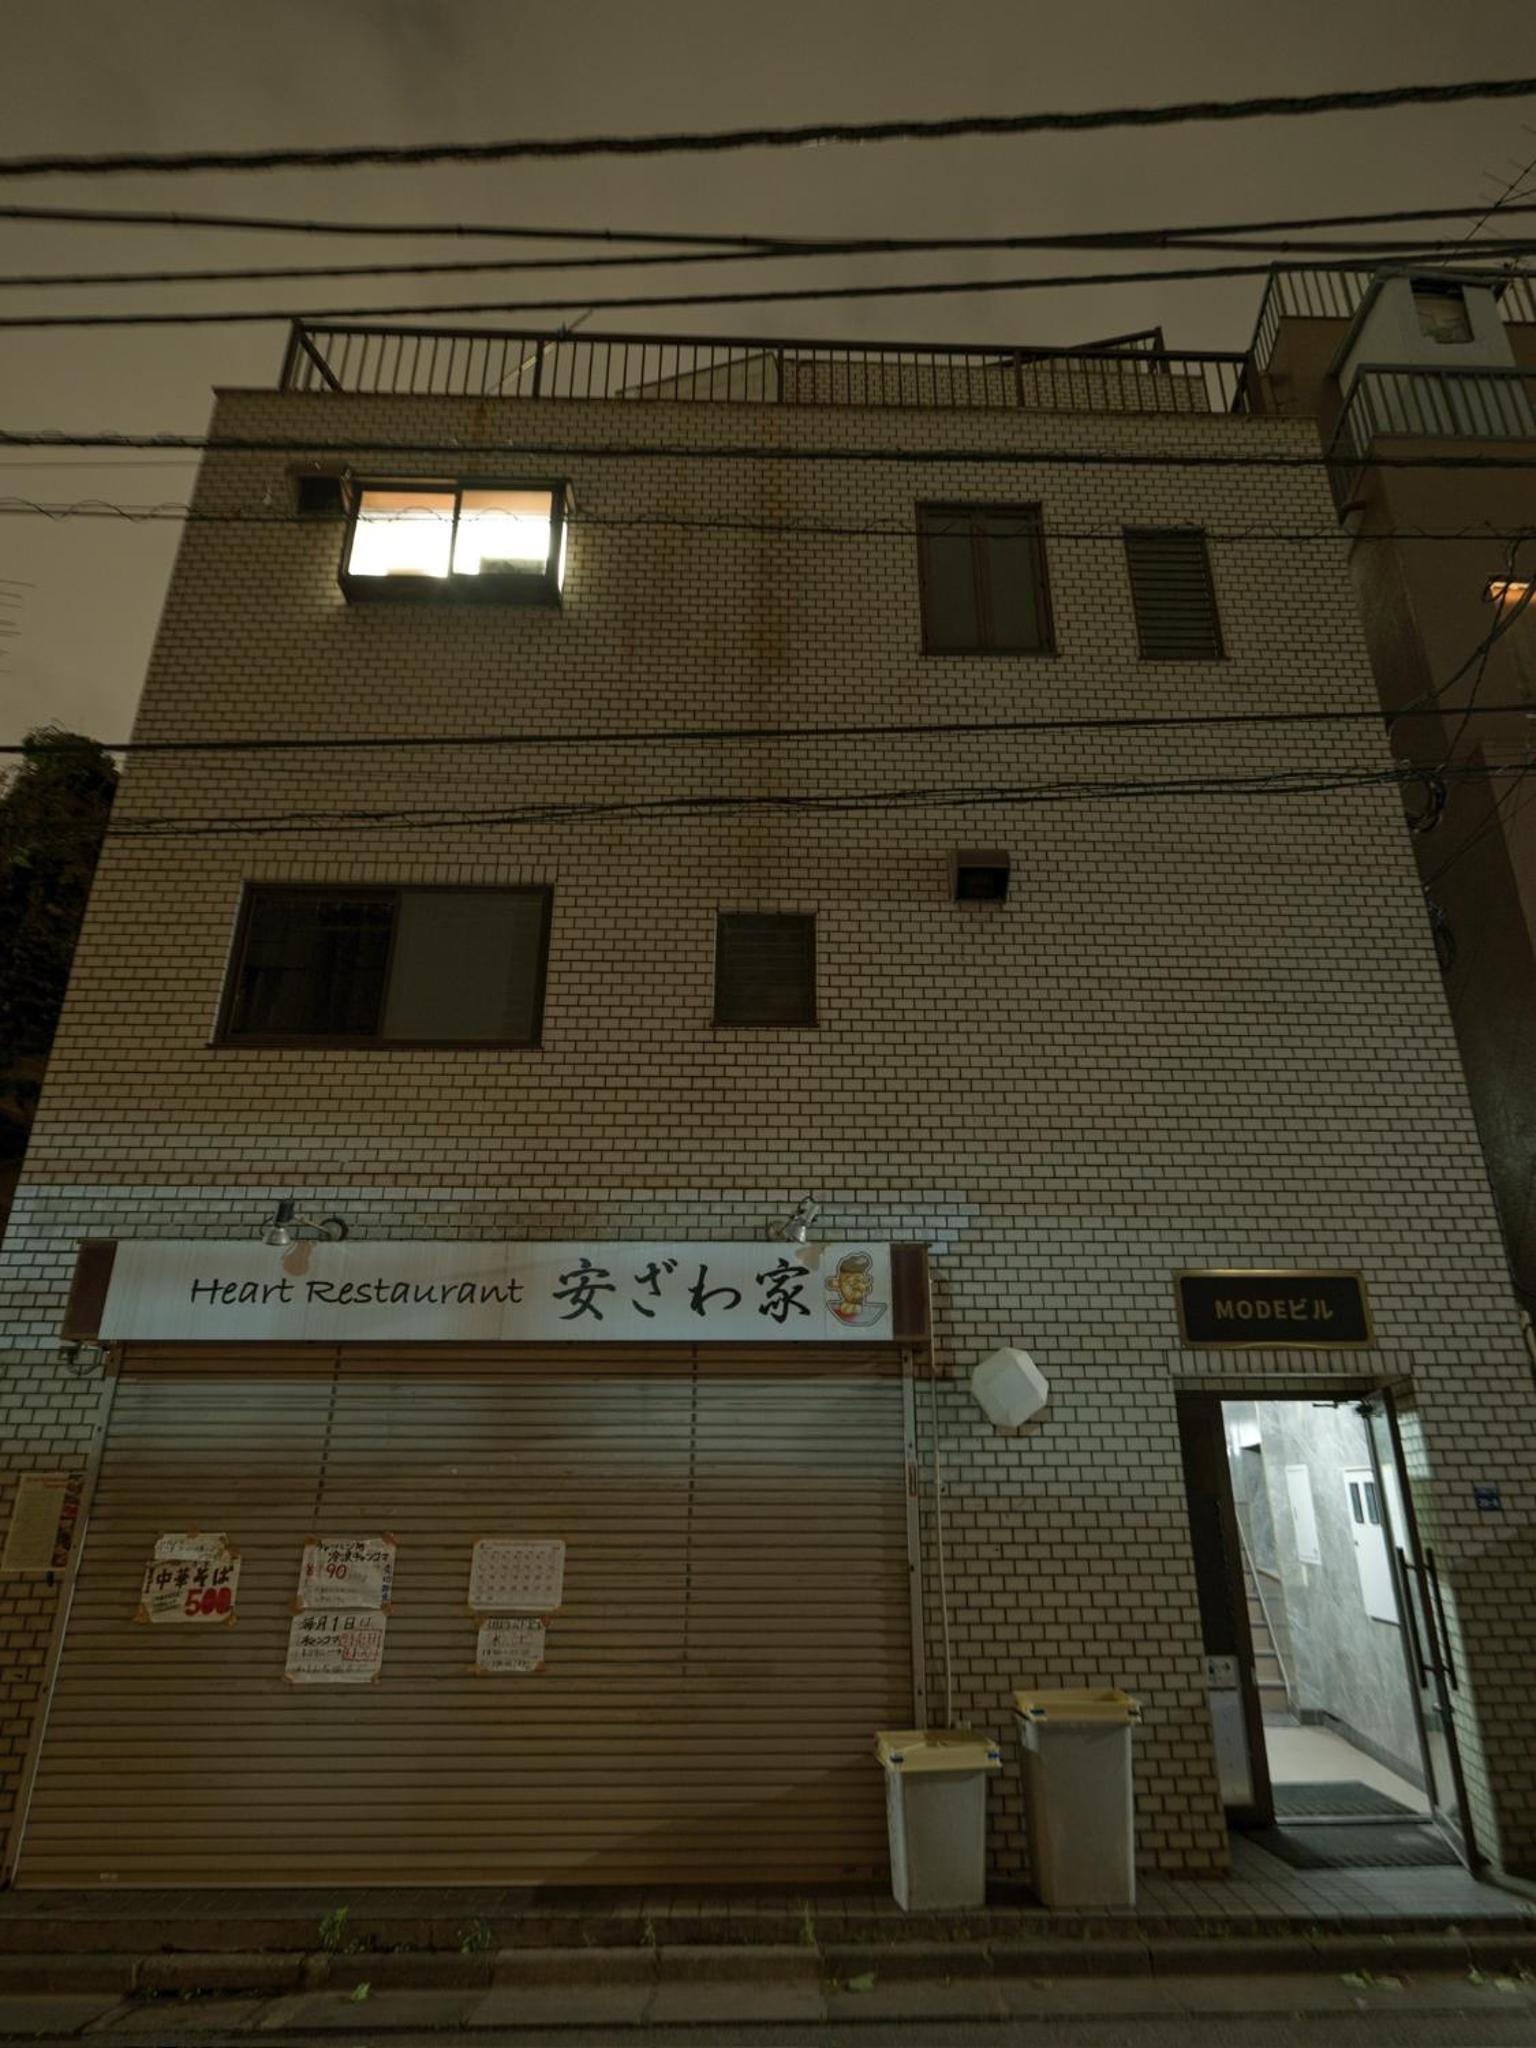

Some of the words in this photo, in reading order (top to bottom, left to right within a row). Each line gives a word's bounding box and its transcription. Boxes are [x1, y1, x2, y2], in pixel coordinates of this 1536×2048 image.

[191, 1277, 293, 1306] Heart
[305, 1279, 524, 1306] Restaurant
[552, 1257, 812, 1322] 安ざわ家
[1214, 1298, 1334, 1321] MODEビル
[156, 1564, 235, 1590] 中華そば
[184, 1587, 232, 1616] 500
